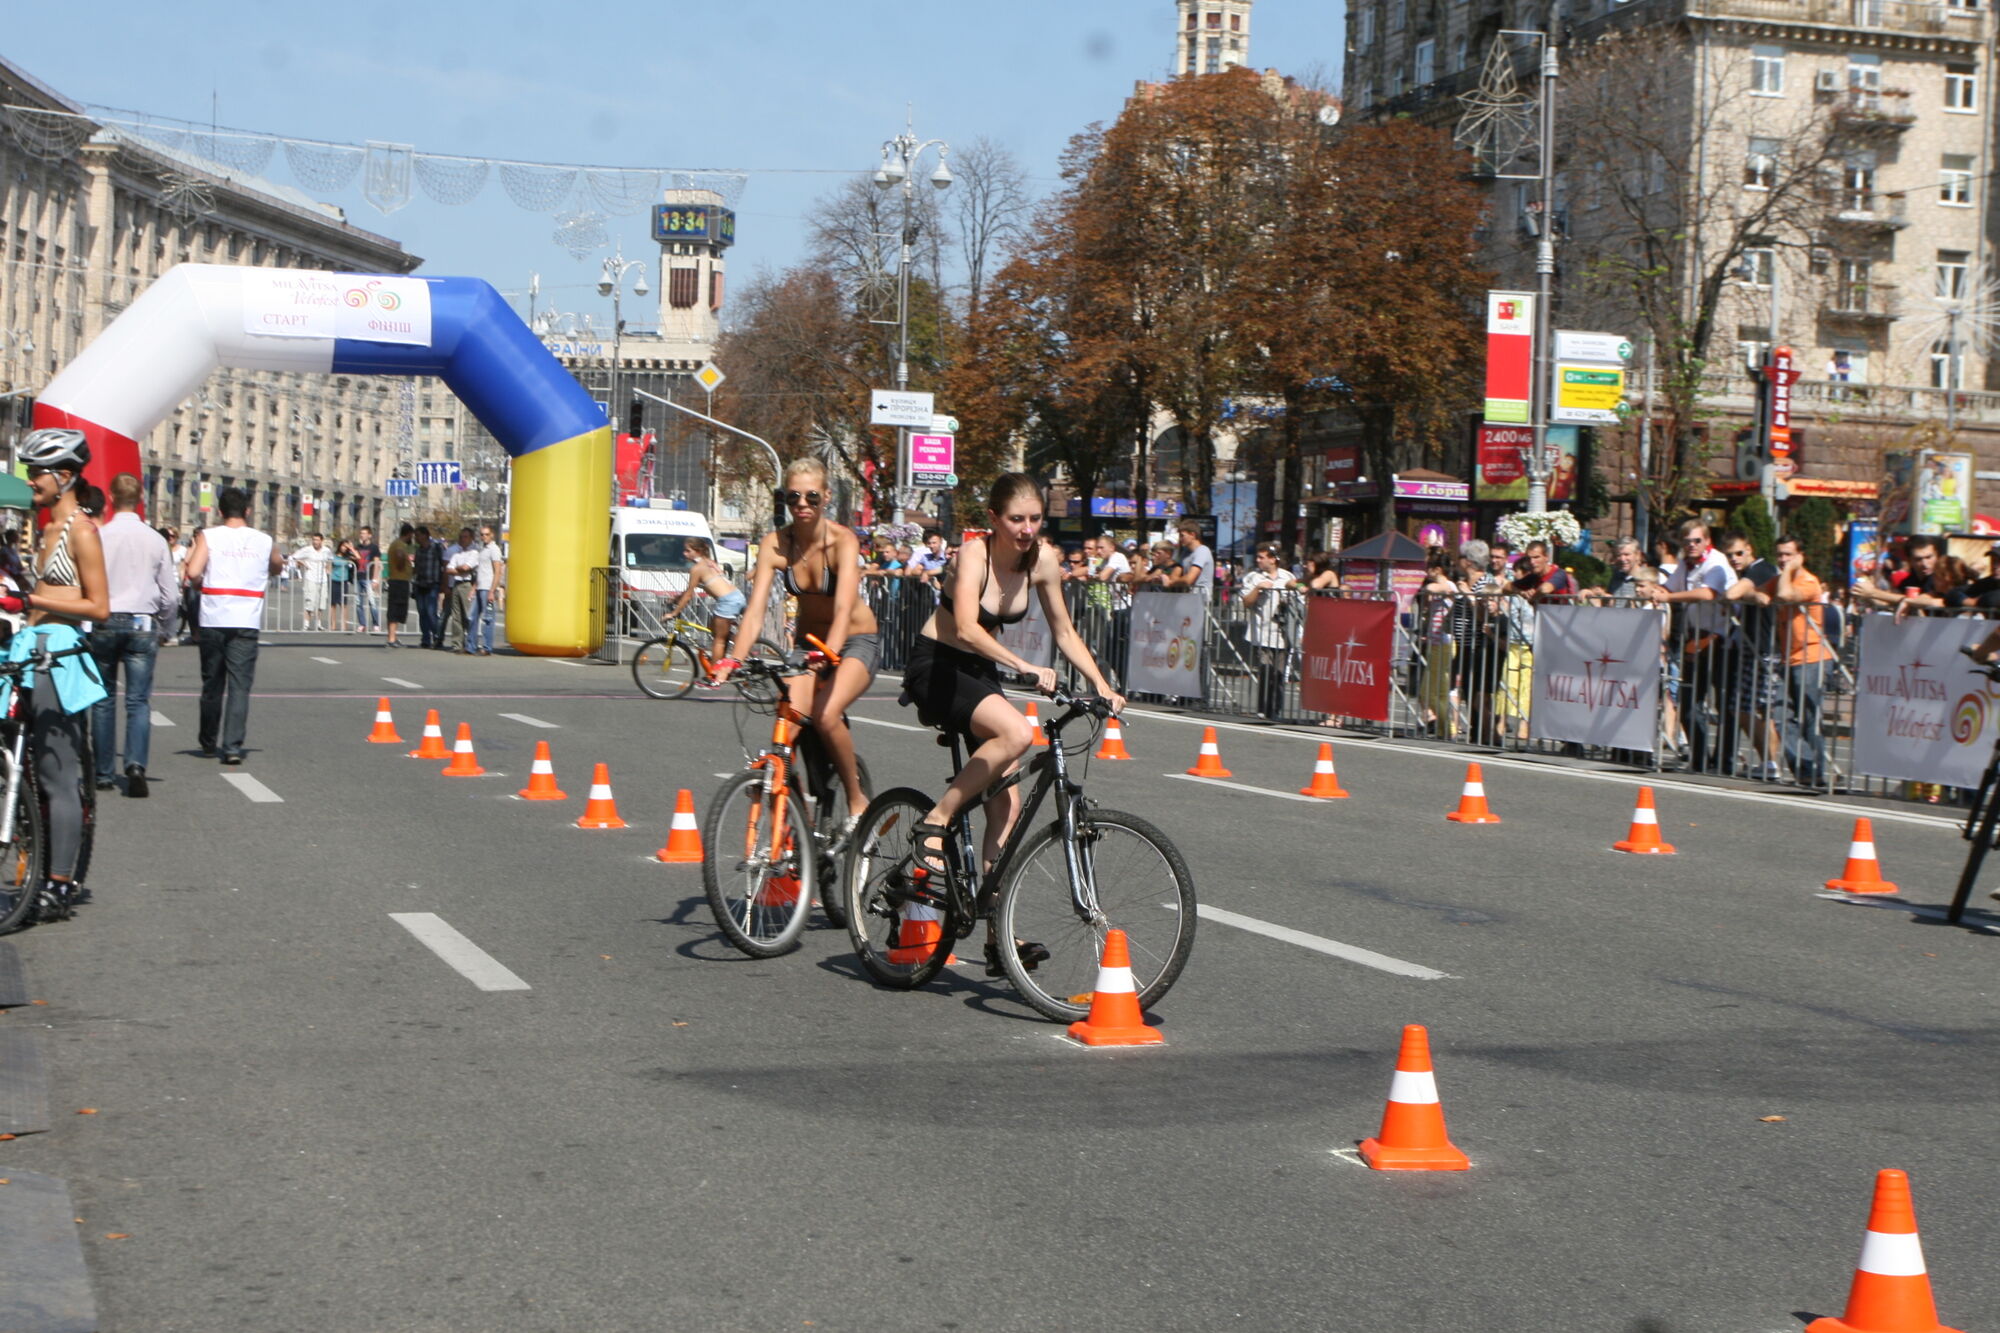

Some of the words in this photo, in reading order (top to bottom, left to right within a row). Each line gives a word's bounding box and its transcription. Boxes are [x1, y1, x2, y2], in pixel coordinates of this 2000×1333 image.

[661, 211, 706, 231] 13:34
[263, 313, 309, 327] СТАРТ
[1485, 430, 1517, 443] 2400
[1310, 644, 1376, 688] MILAVITSA
[1866, 665, 1948, 702] MILAVITSA
[1545, 661, 1640, 712] MILAVITSA
[1887, 704, 1945, 746] Velofest
